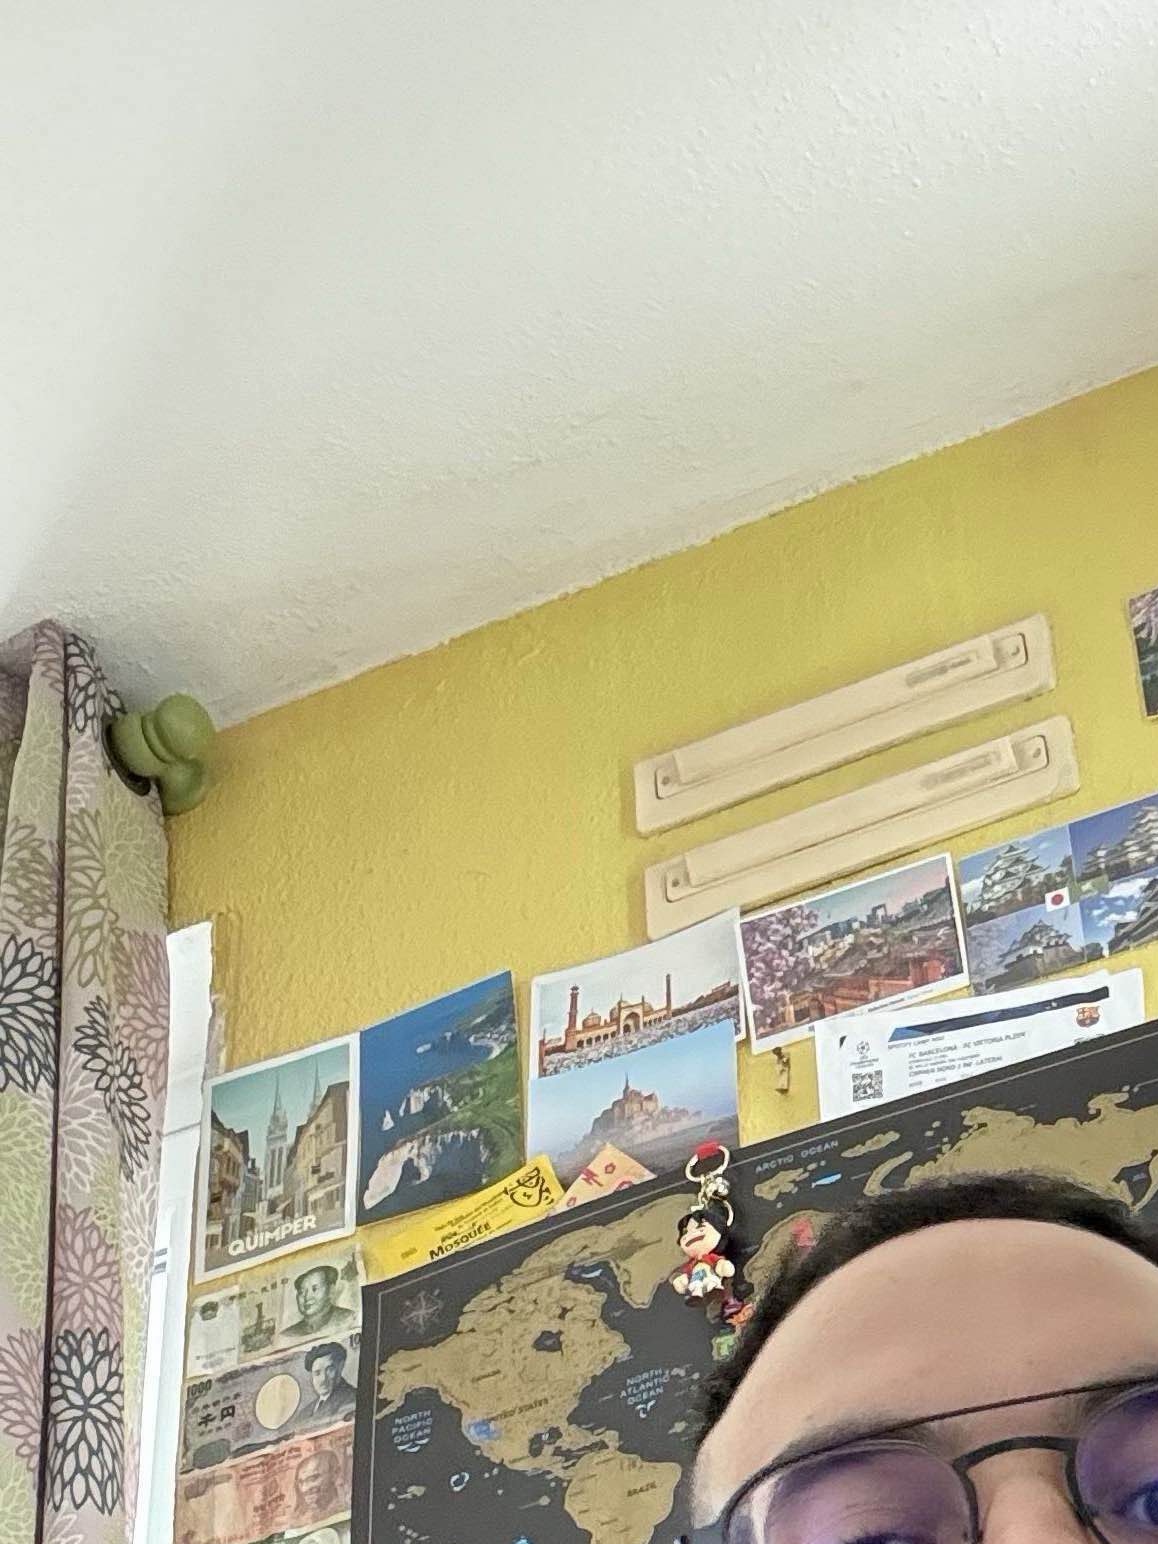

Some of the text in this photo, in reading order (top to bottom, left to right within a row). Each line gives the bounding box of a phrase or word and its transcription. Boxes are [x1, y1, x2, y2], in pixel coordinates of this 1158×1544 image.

[755, 1140, 839, 1174] ARCTIC OCEAN
[228, 1214, 317, 1257] QUIMPER
[626, 1367, 663, 1387] NORTH
[627, 1384, 664, 1405] OCEAN
[391, 1417, 433, 1437] PACIFIC
[394, 1409, 431, 1425] NORTH
[393, 1427, 431, 1444] OCEAN
